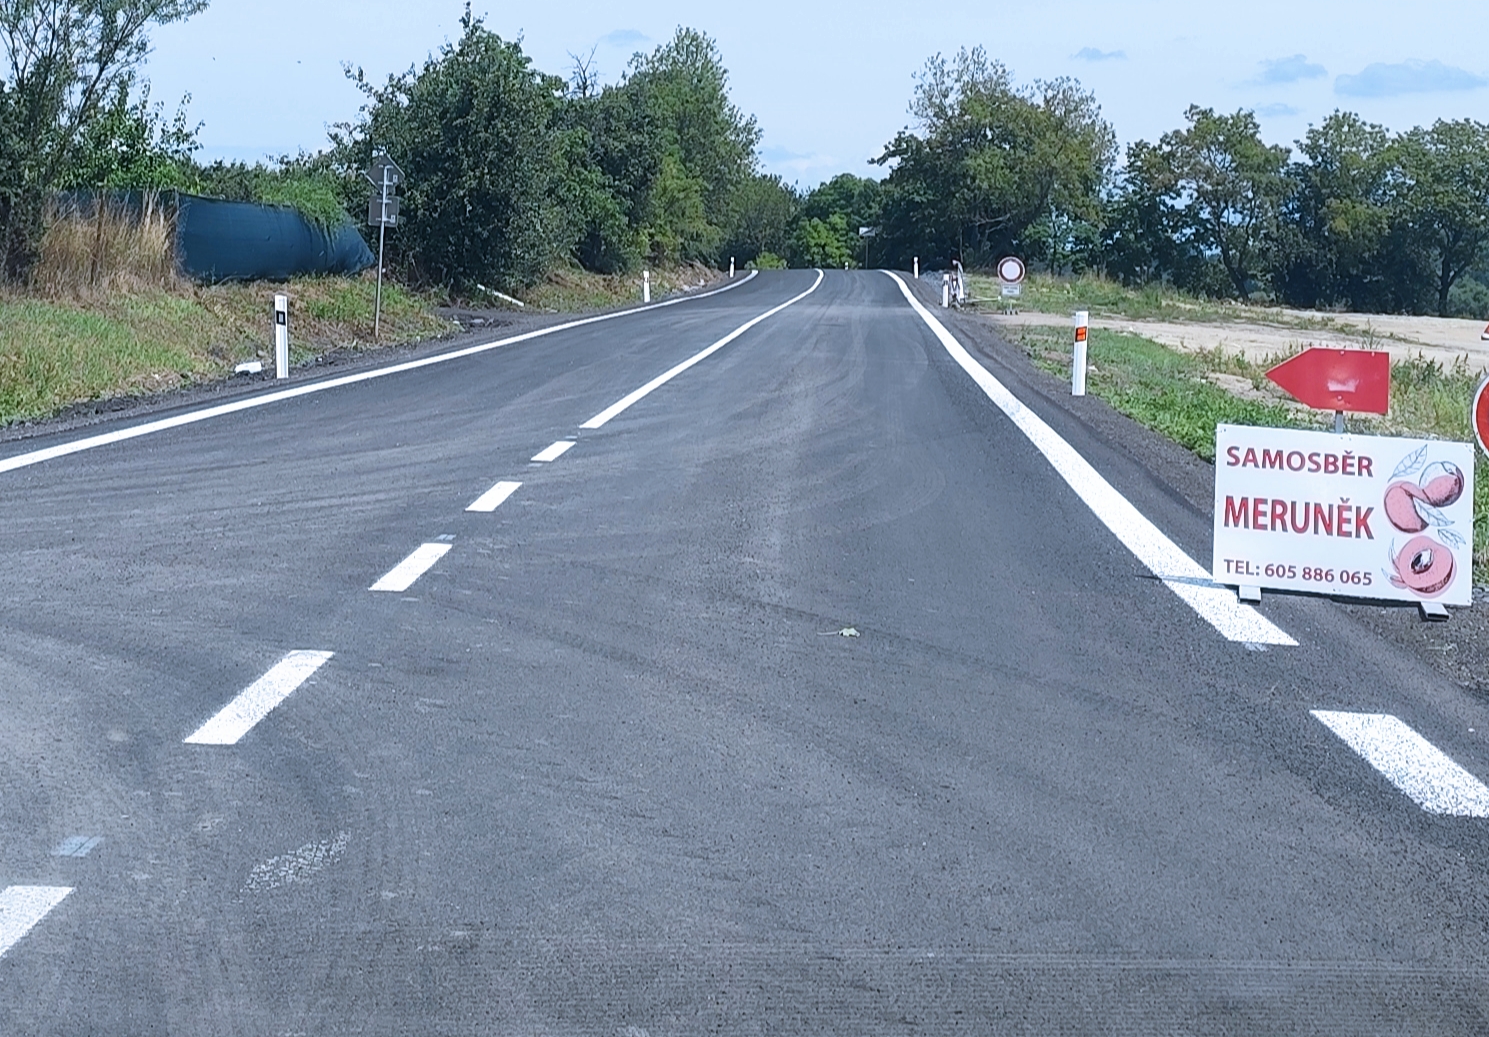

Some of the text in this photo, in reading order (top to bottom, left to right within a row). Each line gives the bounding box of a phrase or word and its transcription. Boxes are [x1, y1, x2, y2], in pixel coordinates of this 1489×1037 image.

[1226, 446, 1374, 477] SAMOSBĚR
[1223, 495, 1375, 540] MERUNĚK
[1223, 559, 1373, 586] TEL: 605 886 065
